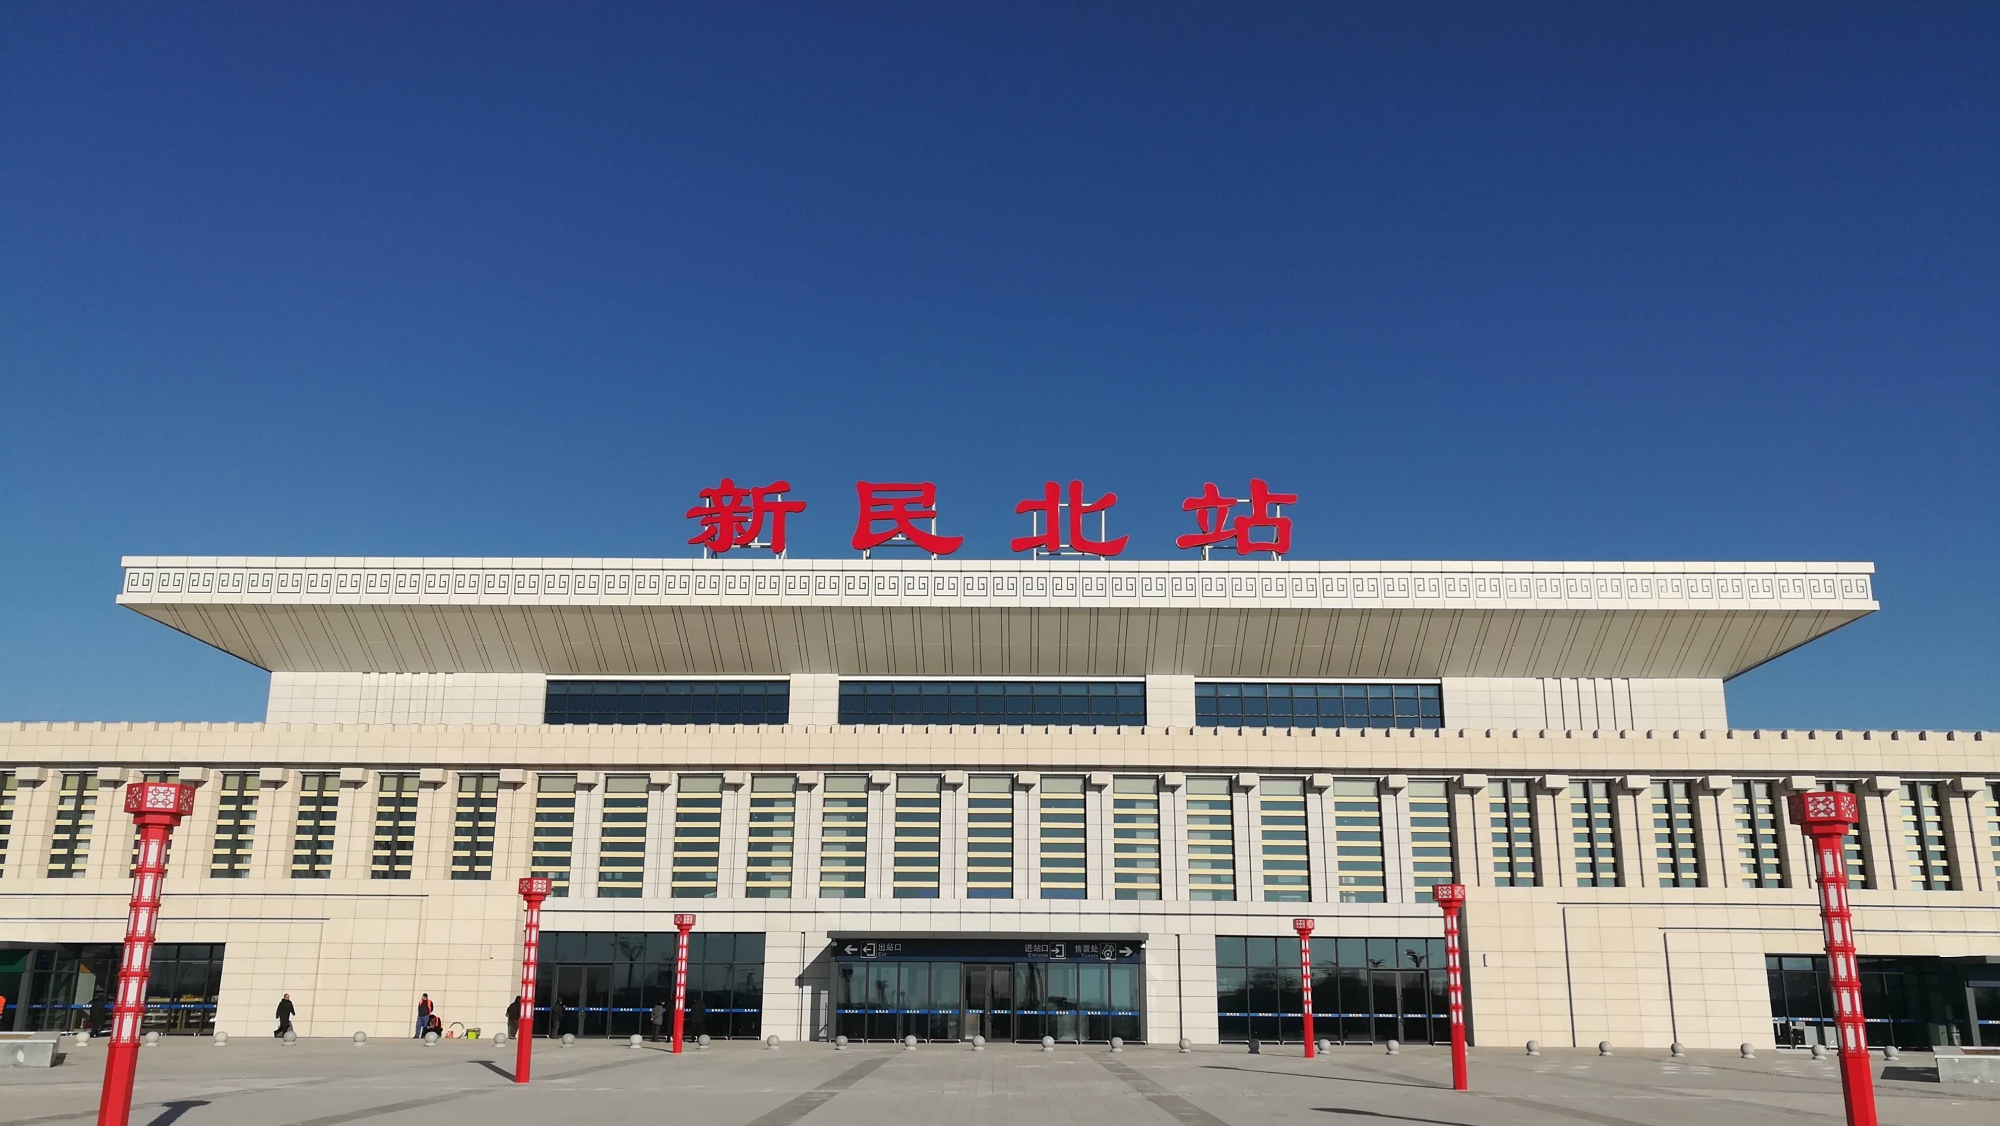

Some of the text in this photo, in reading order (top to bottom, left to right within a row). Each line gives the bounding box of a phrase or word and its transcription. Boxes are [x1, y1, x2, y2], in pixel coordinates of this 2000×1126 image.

[686, 478, 1298, 556] 新民北站
[878, 942, 902, 952] 出站口
[1024, 943, 1049, 952] 进站口
[1074, 944, 1099, 953] 售票处
